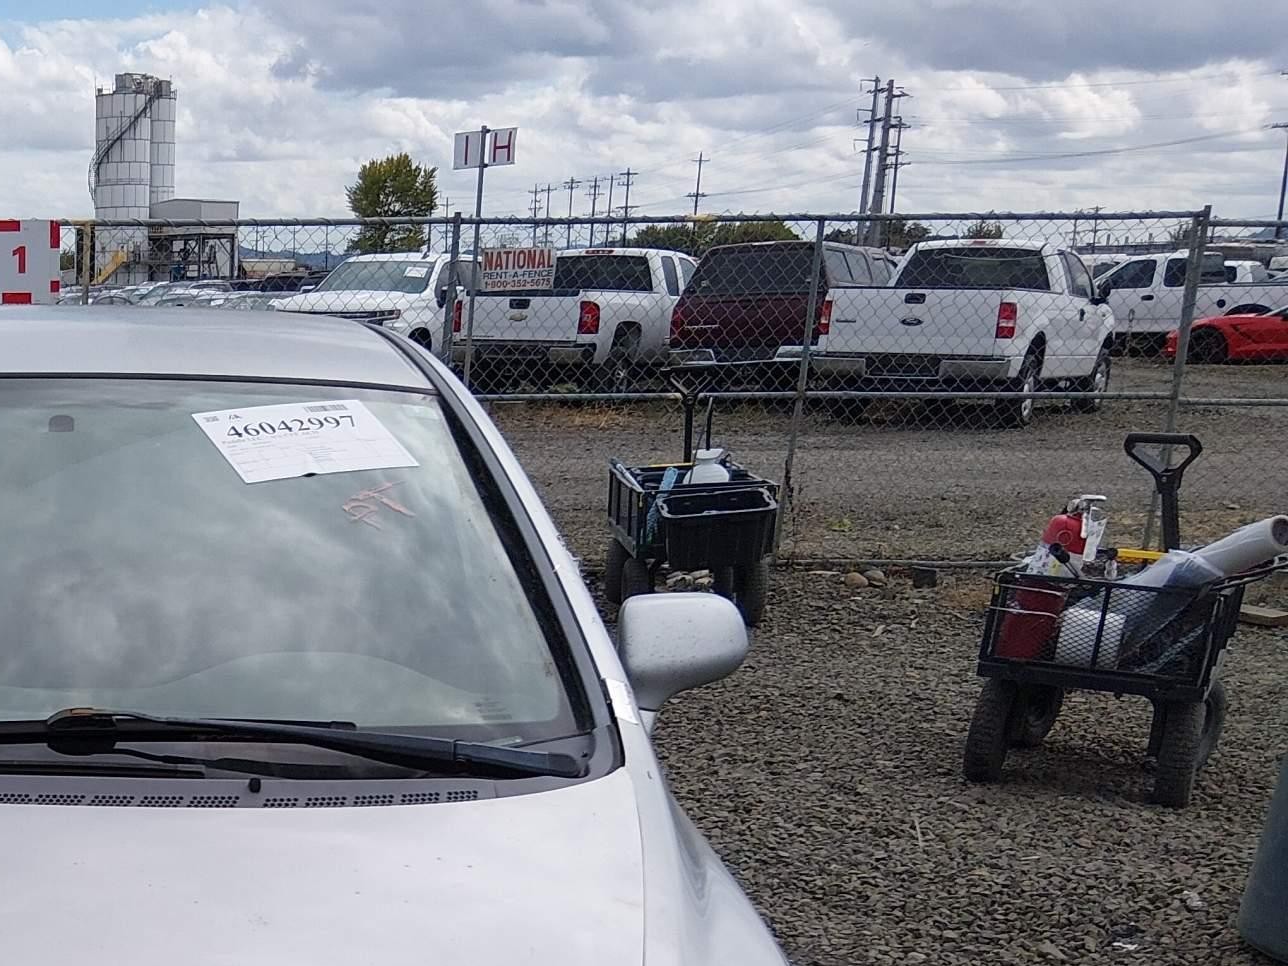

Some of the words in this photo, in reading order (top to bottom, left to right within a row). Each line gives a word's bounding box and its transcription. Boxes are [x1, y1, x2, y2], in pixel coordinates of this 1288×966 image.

[492, 130, 513, 163] H
[11, 245, 26, 274] 1
[483, 248, 554, 271] NATIONAL
[482, 269, 553, 281] RENT-A-FENCE
[226, 414, 356, 439] 46042997
